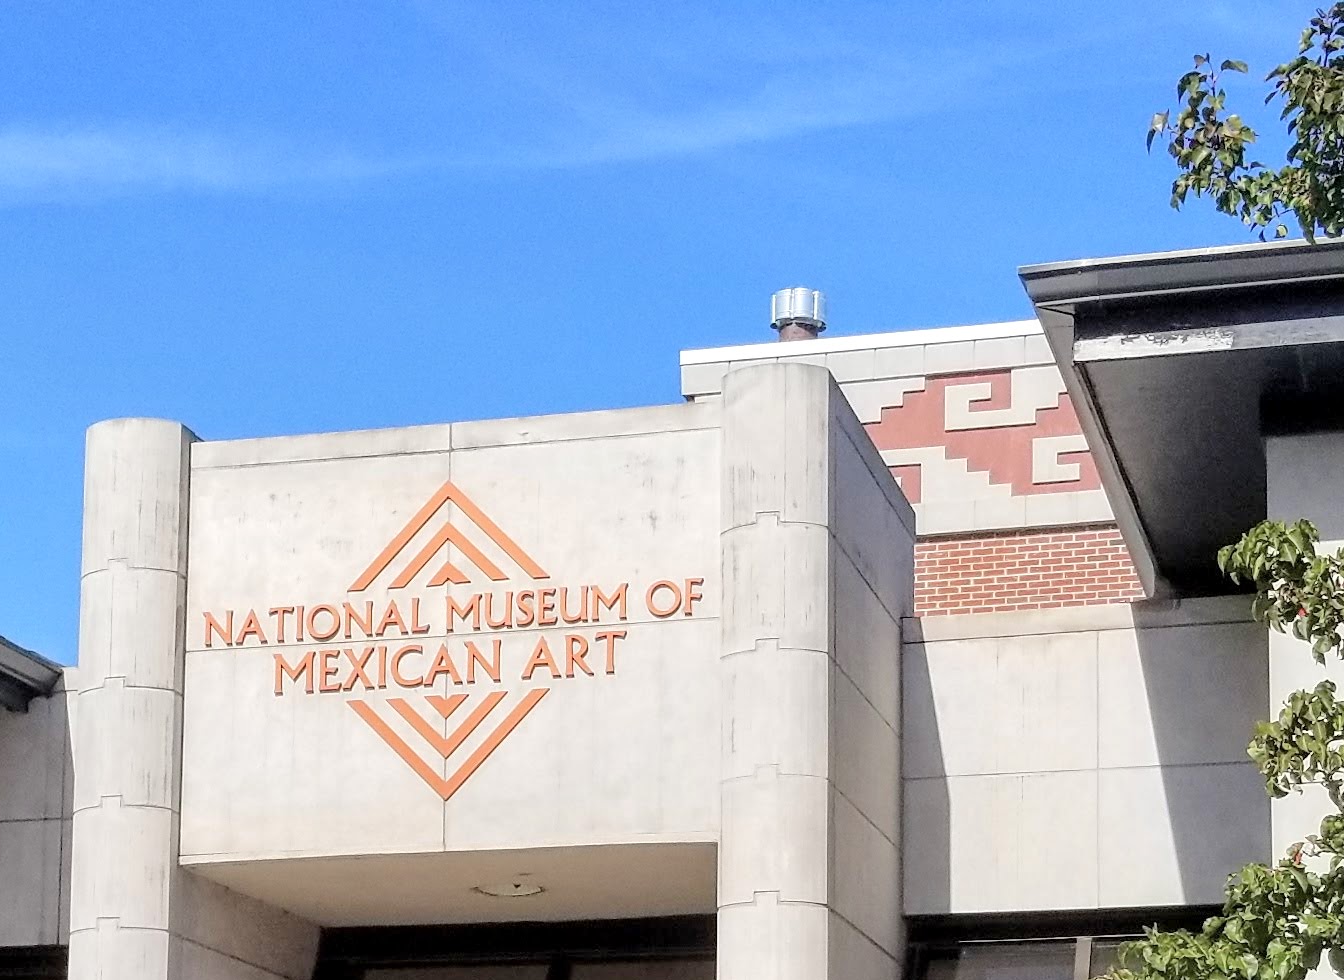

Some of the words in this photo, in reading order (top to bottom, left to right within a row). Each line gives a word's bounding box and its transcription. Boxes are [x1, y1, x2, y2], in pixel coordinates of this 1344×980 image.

[203, 597, 430, 647] NATIONAL
[445, 583, 628, 633] MUSEUM
[645, 577, 705, 618] OF
[273, 638, 502, 696] MEXICAN
[522, 630, 627, 680] ART
